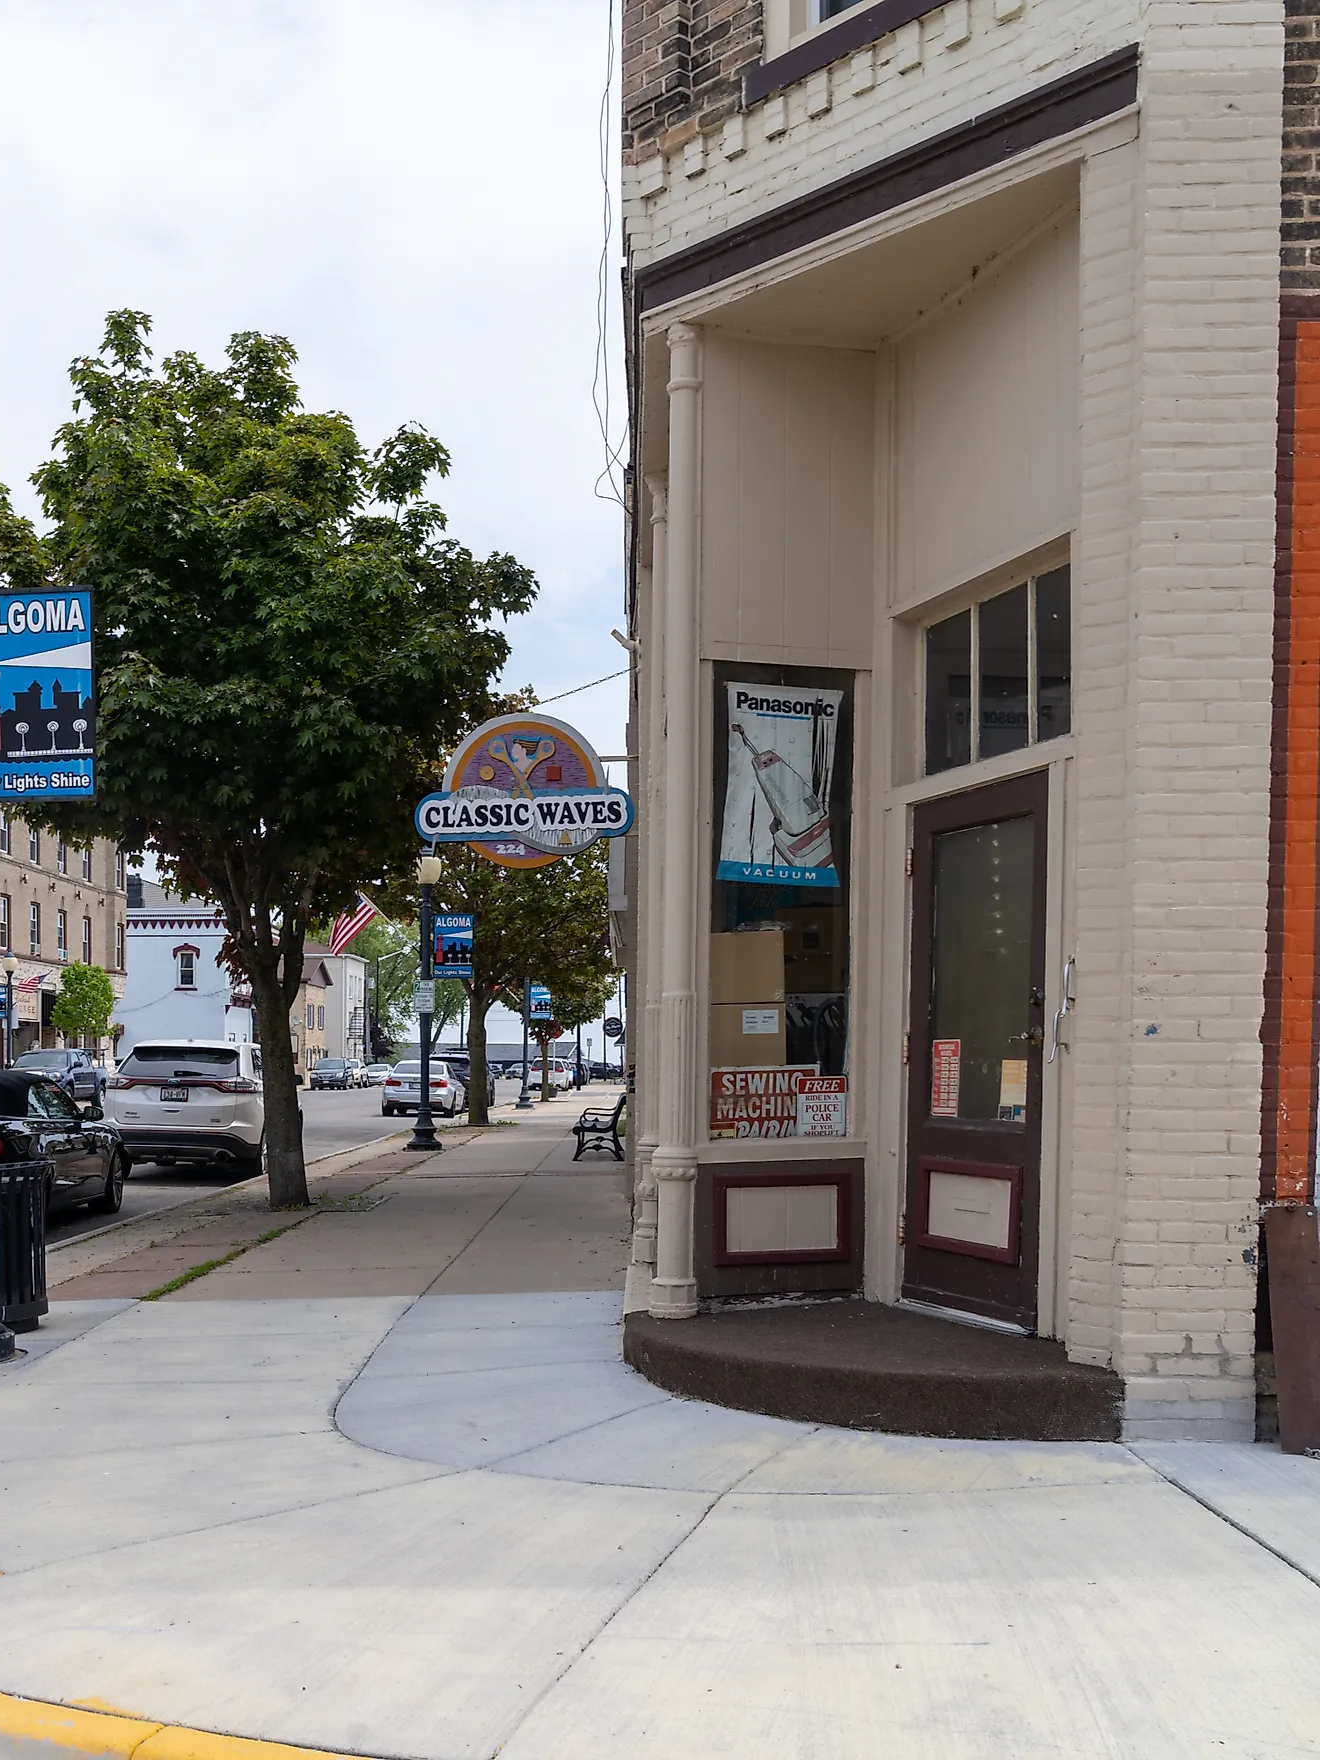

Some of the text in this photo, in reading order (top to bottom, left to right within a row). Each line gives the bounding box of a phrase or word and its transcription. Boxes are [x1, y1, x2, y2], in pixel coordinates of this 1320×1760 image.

[736, 691, 835, 718] Panasonic
[5, 774, 47, 793] Lights
[51, 772, 90, 789] Shine
[425, 801, 622, 828] CLASSIC WAVES
[496, 843, 526, 855] 224
[743, 867, 817, 880] VACUUM
[435, 917, 471, 927] ALGOMA
[804, 1080, 840, 1092] FREE
[716, 1096, 798, 1119] MACHIN
[805, 1103, 840, 1113] POLICE
[812, 1112, 832, 1122] CAR
[804, 1129, 840, 1137] SHOPLIFT
